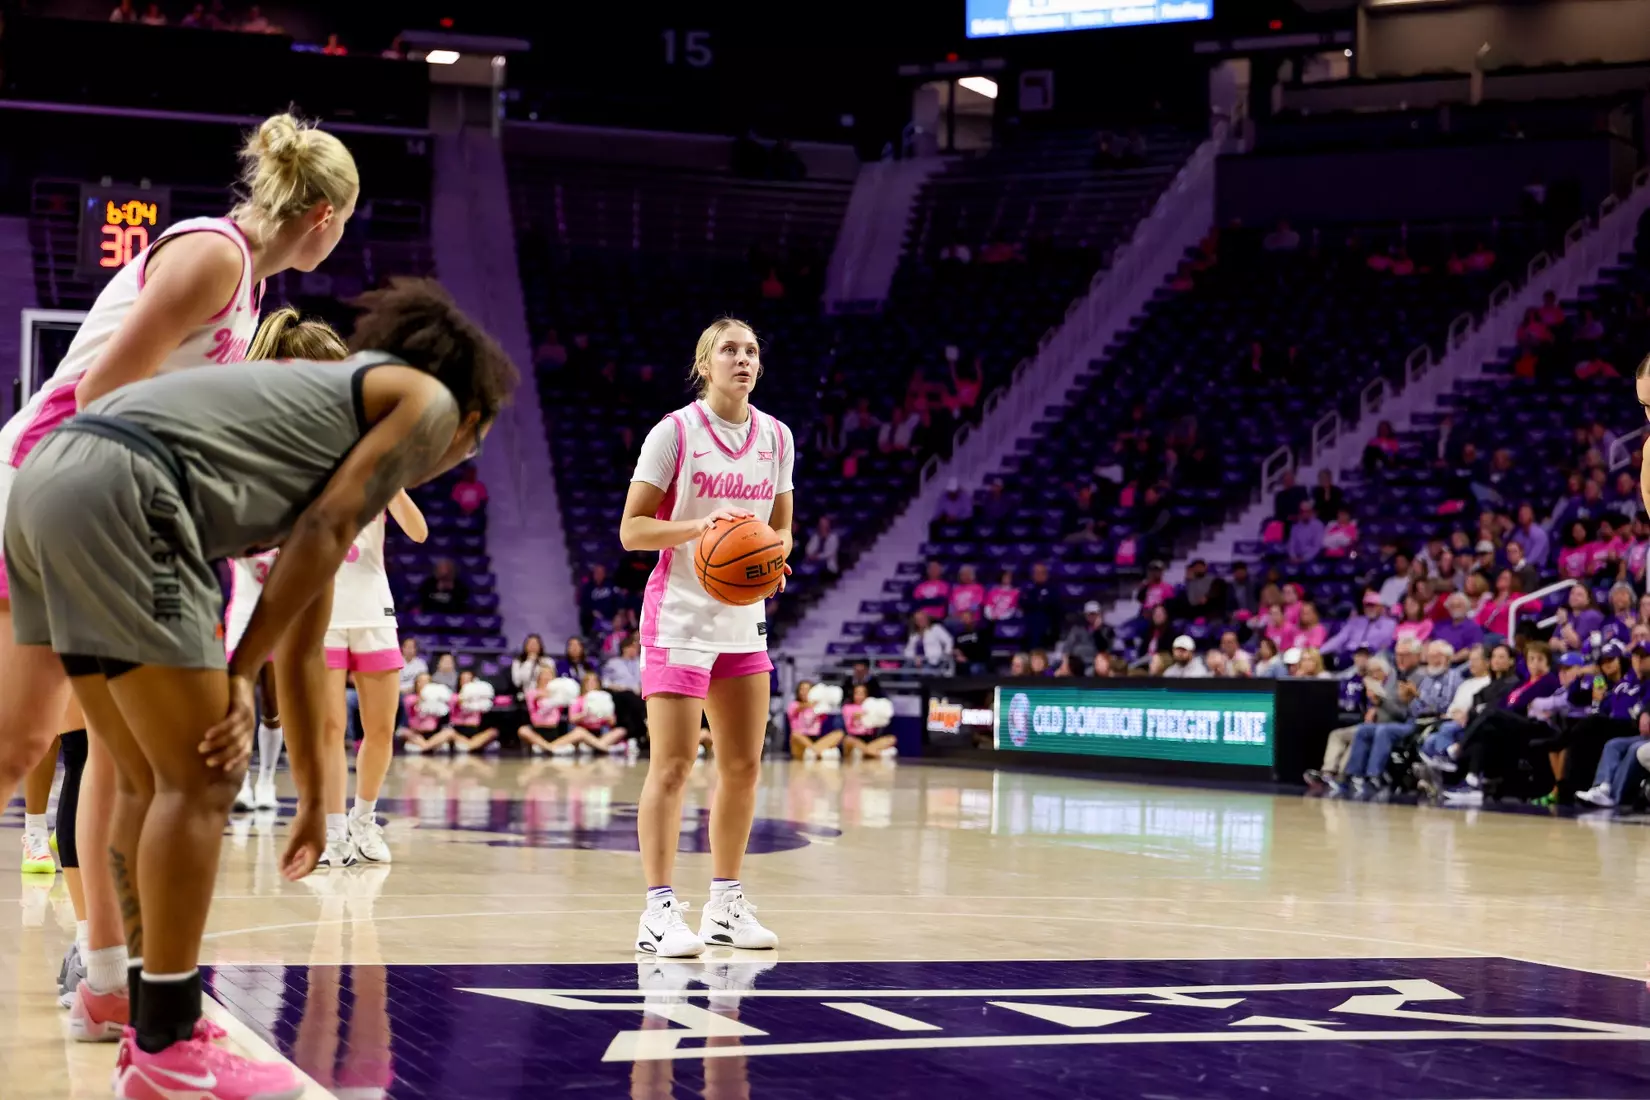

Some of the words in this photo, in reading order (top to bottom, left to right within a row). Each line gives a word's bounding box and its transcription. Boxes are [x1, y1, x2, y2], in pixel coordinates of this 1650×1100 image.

[663, 29, 712, 66] 15
[106, 200, 157, 226] 6:04
[100, 224, 148, 267] 30
[692, 471, 774, 500] Wildcats
[745, 555, 784, 579] ELITE
[1033, 705, 1063, 734] OLD
[1065, 706, 1144, 737] DOMINION
[1146, 708, 1219, 742] FREIGHT
